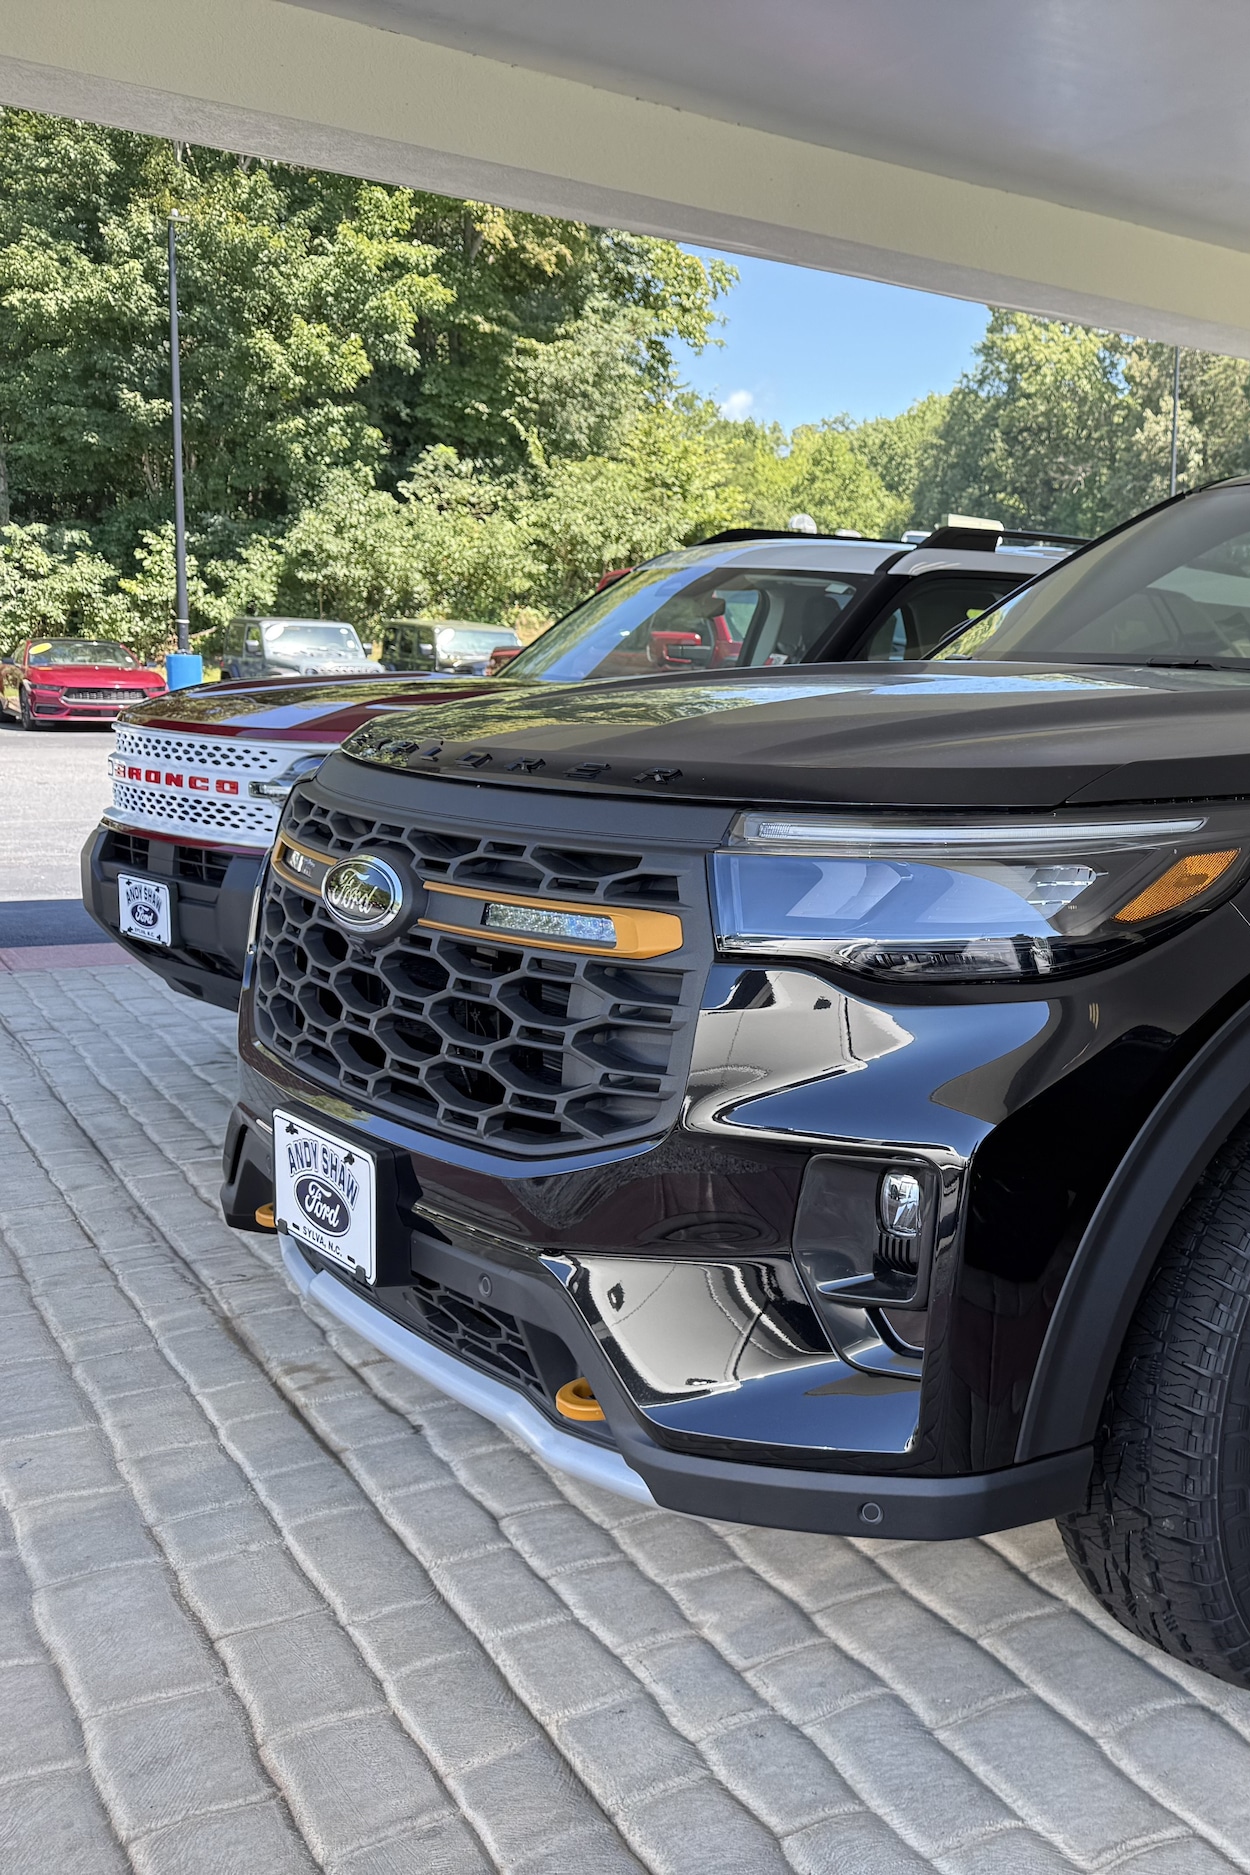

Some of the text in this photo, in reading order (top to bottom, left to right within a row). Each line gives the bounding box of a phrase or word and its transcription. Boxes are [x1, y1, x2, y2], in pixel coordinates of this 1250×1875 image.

[115, 762, 239, 795] BRONCO
[126, 885, 162, 913] ANDY SHAW
[332, 868, 378, 914] Ford
[135, 905, 154, 925] Ford
[287, 1138, 360, 1211] ANDY SHAW
[305, 1181, 340, 1228] Ford
[303, 1226, 343, 1257] SYLVA, N.C.
